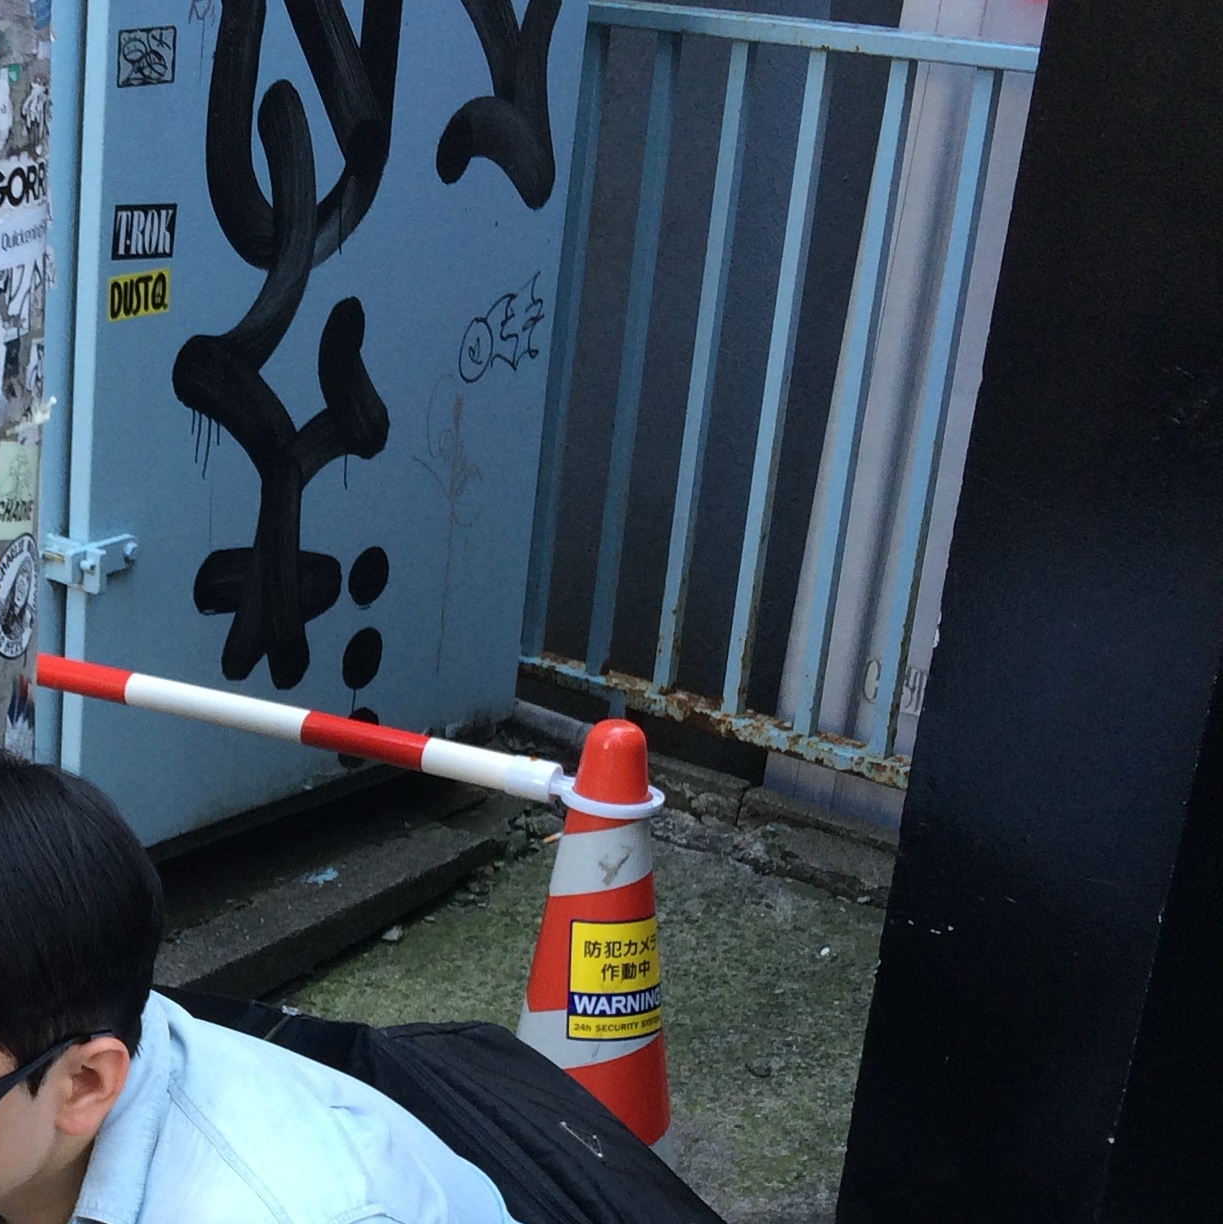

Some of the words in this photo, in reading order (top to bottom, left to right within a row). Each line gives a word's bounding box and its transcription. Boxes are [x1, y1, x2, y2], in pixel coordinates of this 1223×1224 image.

[601, 960, 651, 982] 作動中
[573, 987, 661, 1016] WARNING
[573, 1022, 592, 1032] 24h
[595, 1021, 640, 1033] SECURITY
